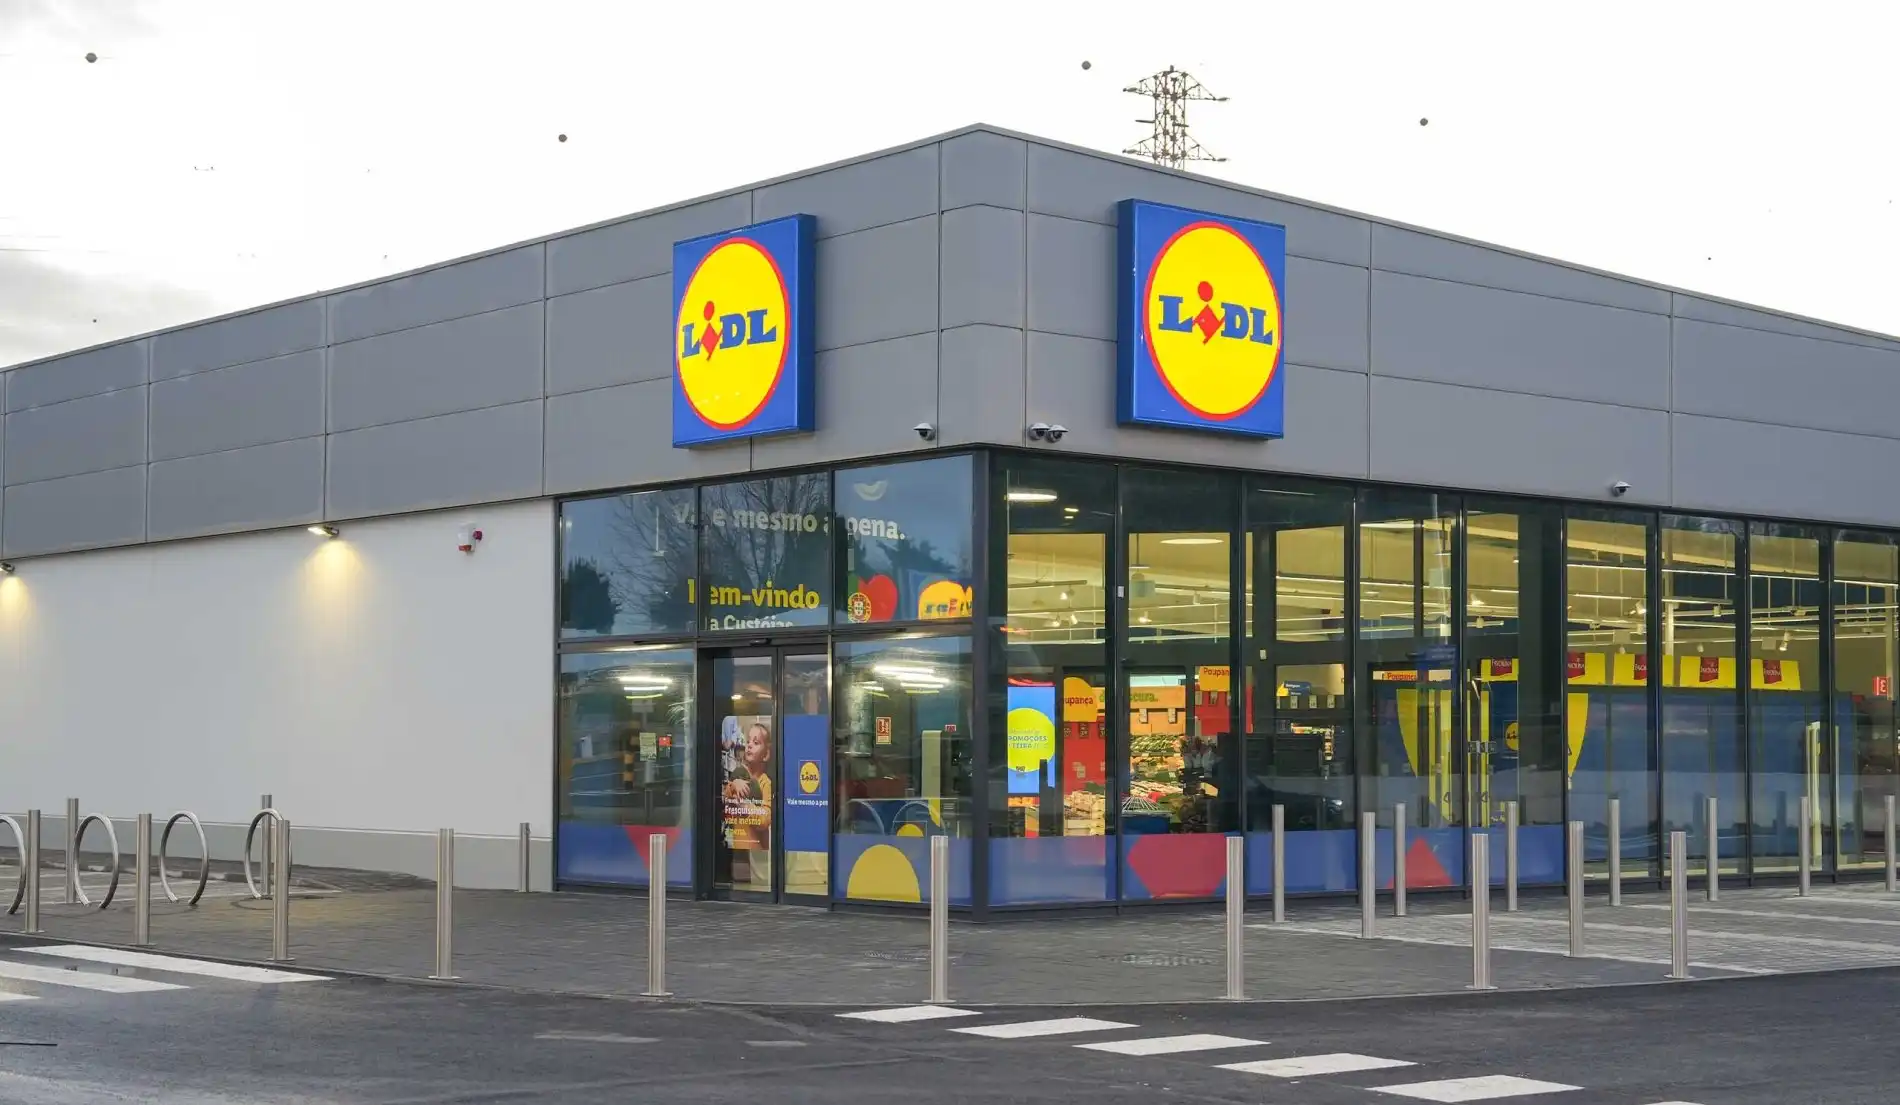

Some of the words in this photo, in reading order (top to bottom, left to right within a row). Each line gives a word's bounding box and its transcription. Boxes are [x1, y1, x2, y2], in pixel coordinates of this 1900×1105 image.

[673, 503, 726, 528] Ve
[733, 508, 818, 532] mesmo
[1204, 668, 1229, 677] Poupan
[1064, 696, 1094, 707] upança
[819, 800, 829, 808] pen
